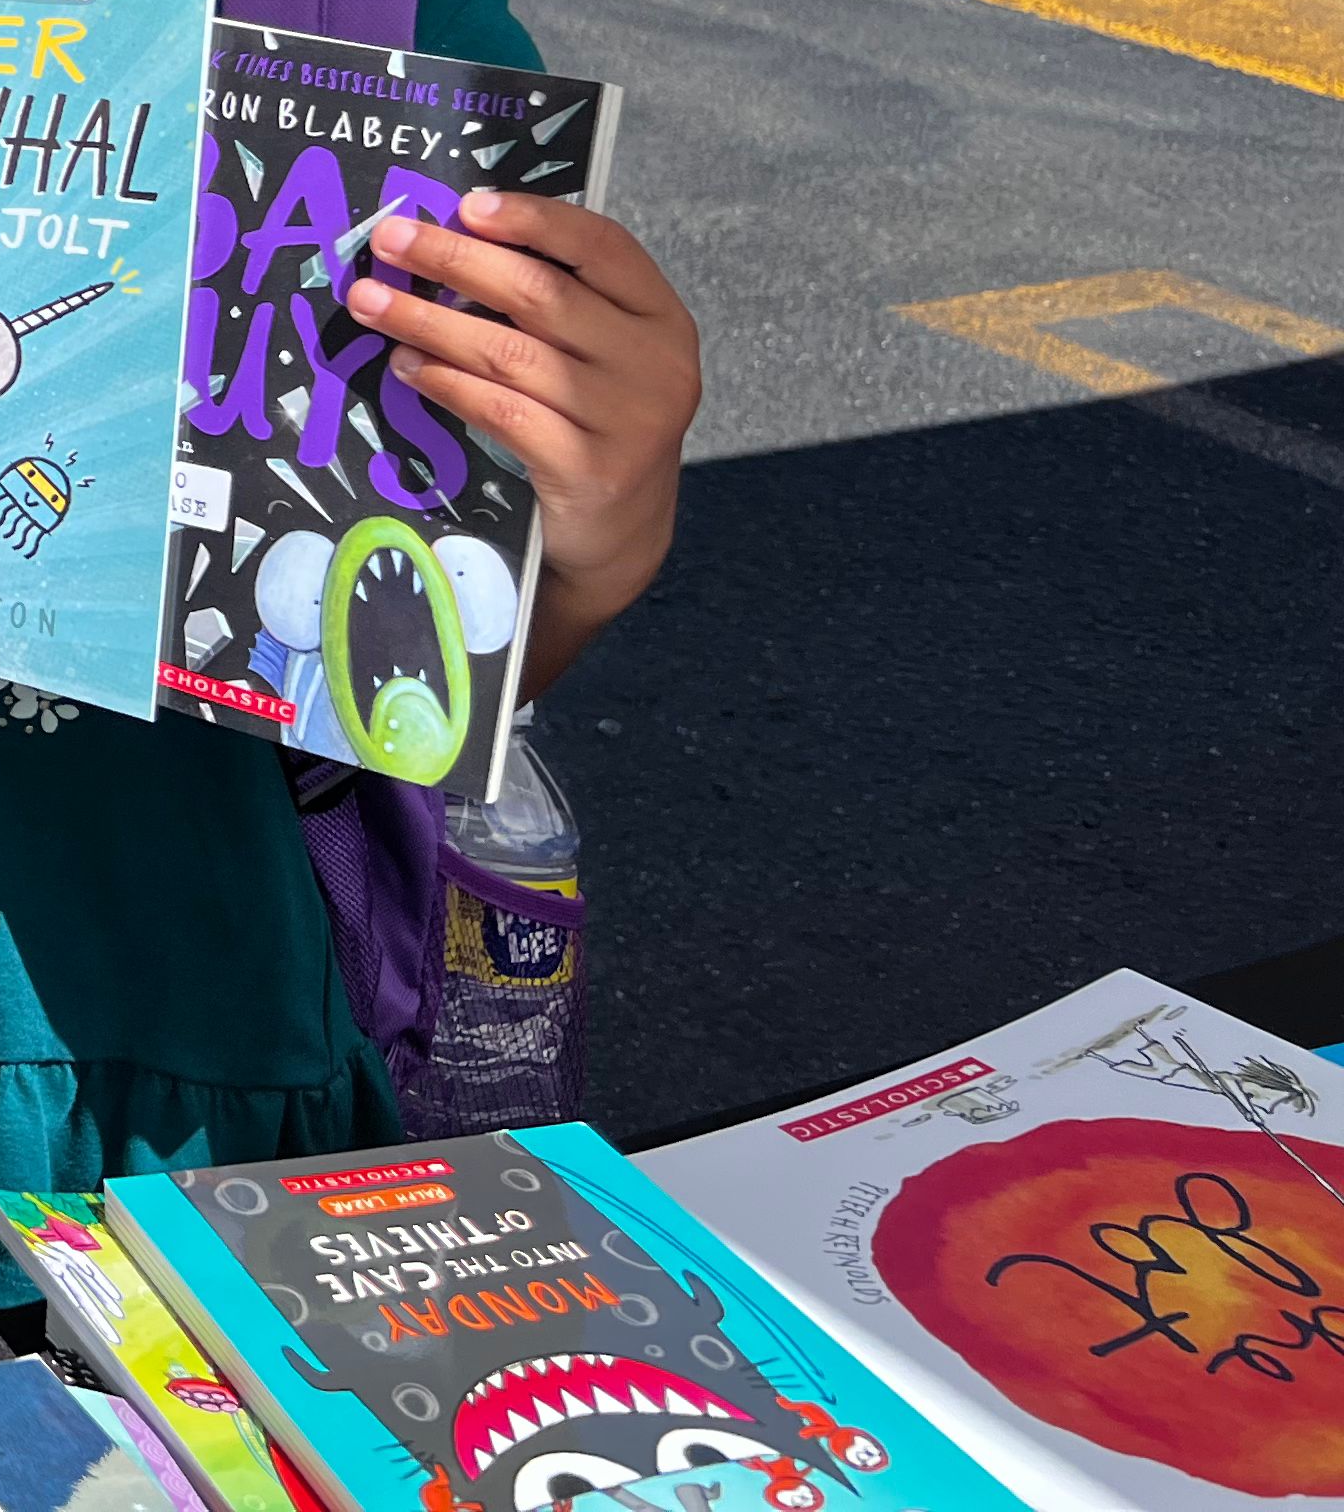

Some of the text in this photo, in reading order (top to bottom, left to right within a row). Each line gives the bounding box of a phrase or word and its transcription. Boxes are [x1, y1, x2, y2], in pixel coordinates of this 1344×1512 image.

[233, 52, 291, 82] TIMES
[300, 64, 439, 106] BESTSELLING
[452, 88, 526, 120] SERIES
[202, 89, 444, 161] RON BLABEY
[0, 207, 130, 259] JOLT
[184, 286, 469, 509] UYS
[160, 668, 292, 719] CHOLASTIC
[790, 1070, 962, 1139] SCHOLASTIC
[287, 1165, 428, 1191] SCHOLASTIC
[330, 1186, 447, 1214] RALPH LAZAR
[836, 1180, 889, 1218] PETER
[309, 1208, 534, 1266] OF THIEVES
[823, 1231, 892, 1306] REYNOLDS
[315, 1240, 592, 1305] INTO THE CAVE
[378, 1271, 622, 1343] MONDAY
